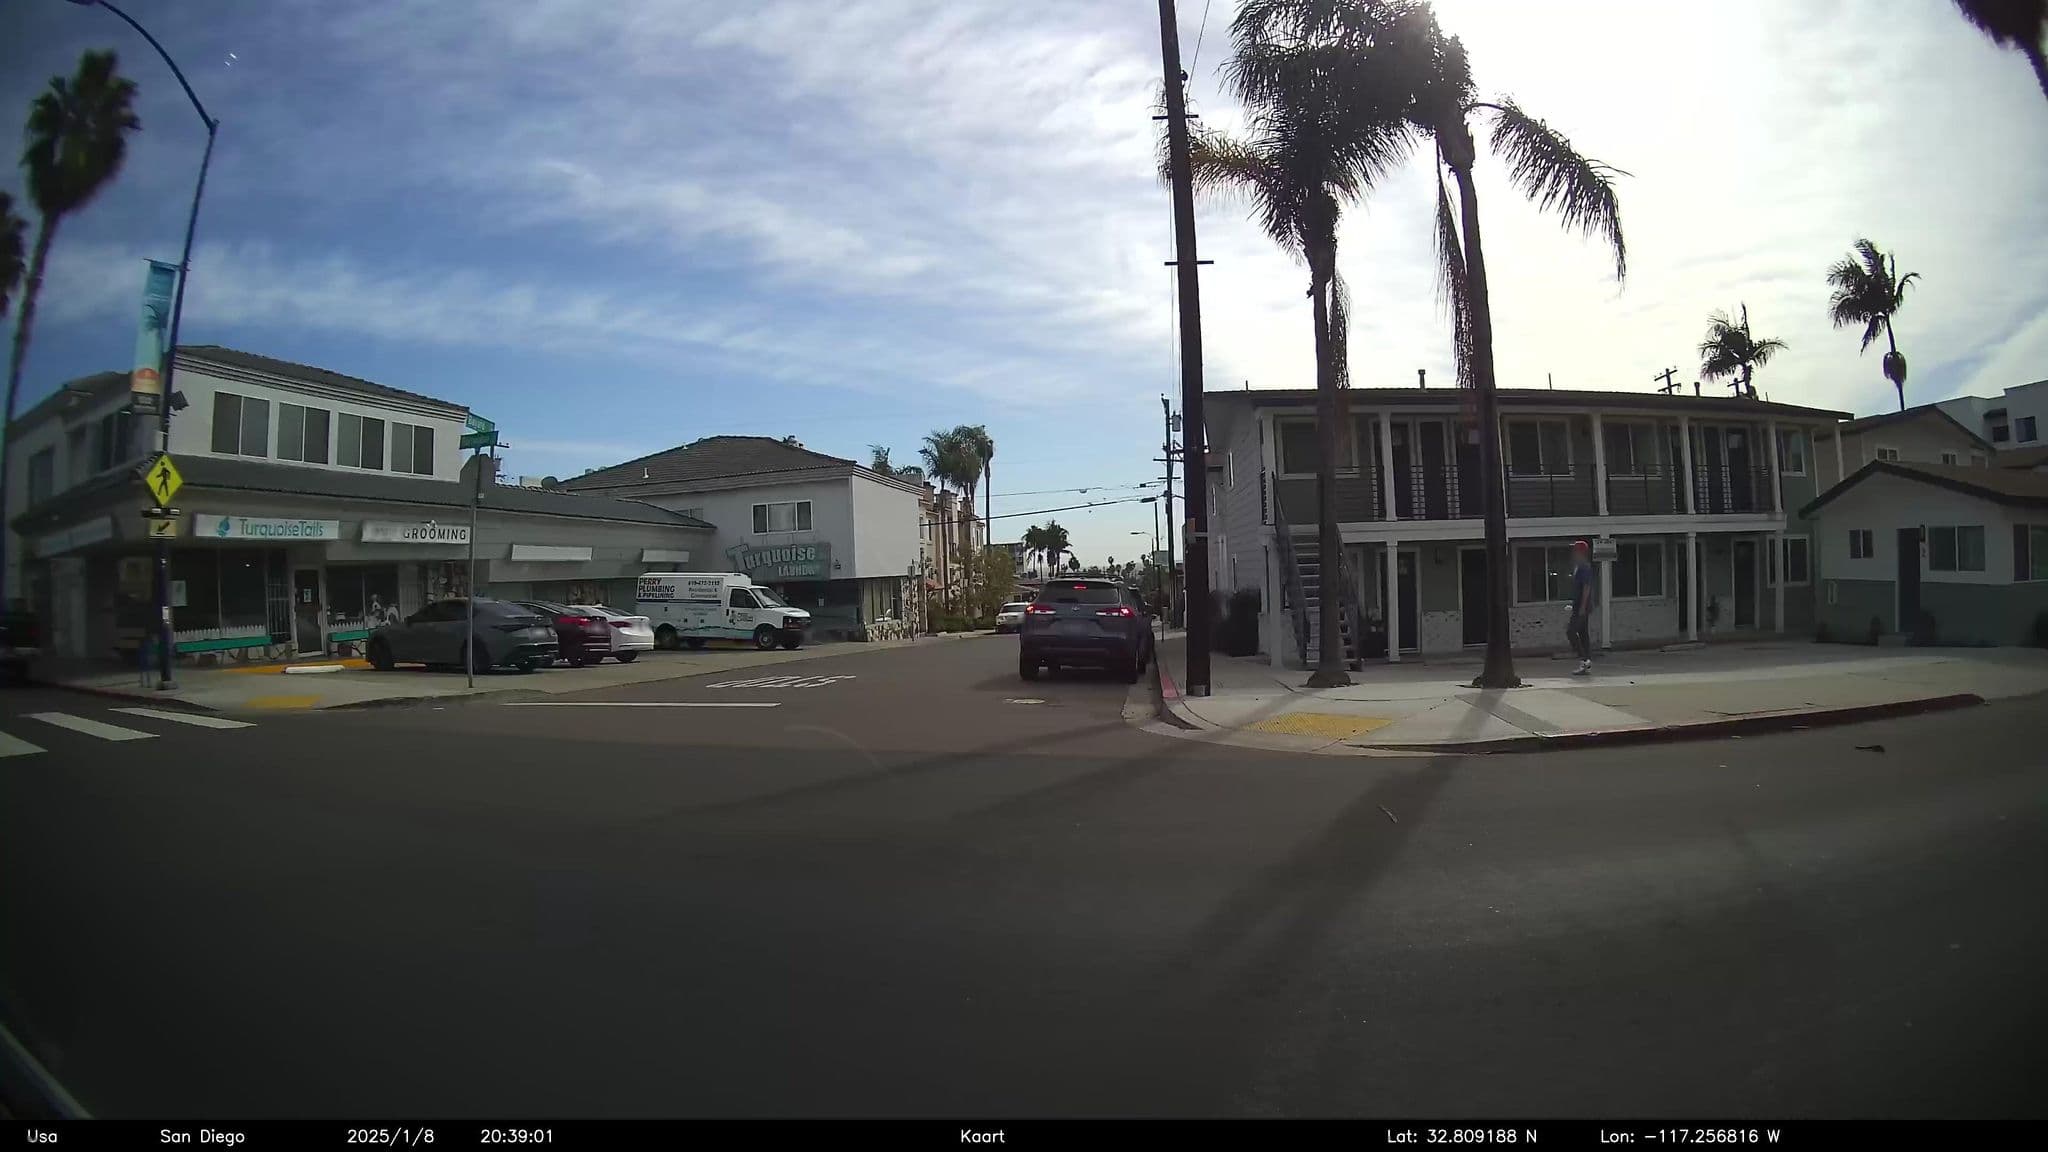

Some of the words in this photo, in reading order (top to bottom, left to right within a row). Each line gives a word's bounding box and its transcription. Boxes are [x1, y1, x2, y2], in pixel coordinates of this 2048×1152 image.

[726, 544, 816, 574] Turquoise
[638, 577, 662, 585] PERRY
[638, 585, 676, 593] PLUMBING
